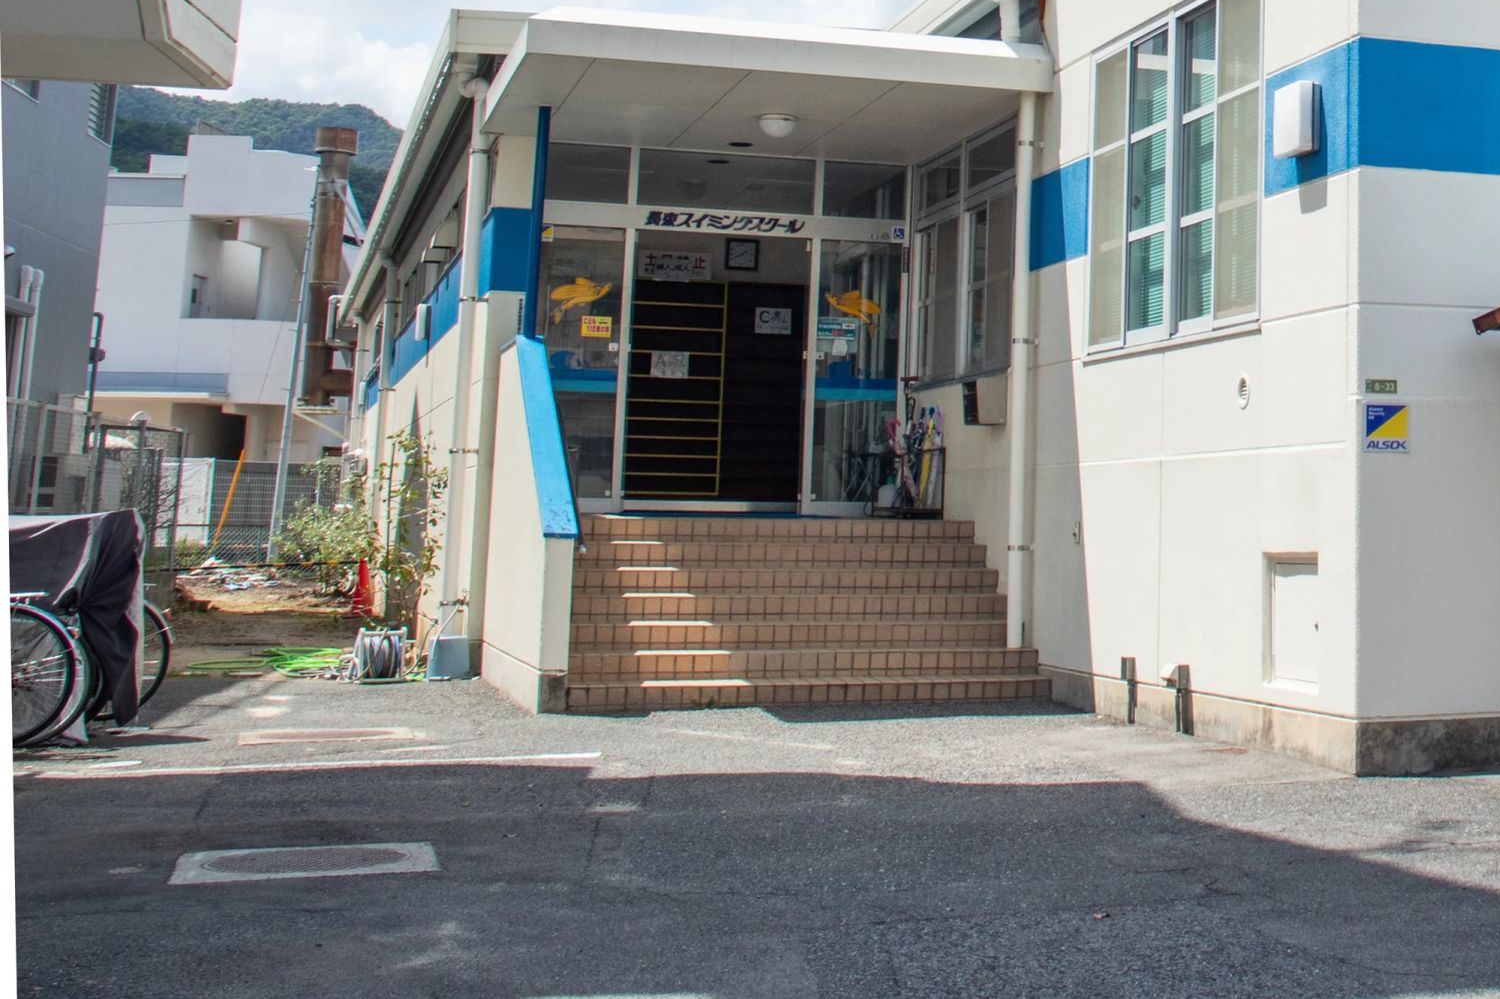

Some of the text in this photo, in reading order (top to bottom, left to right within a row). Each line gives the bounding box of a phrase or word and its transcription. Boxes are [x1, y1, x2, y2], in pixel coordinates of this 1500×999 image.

[645, 211, 805, 233] 長束スイミングスクール
[1374, 382, 1395, 391] 6-33
[1366, 440, 1407, 450] ALSOK
